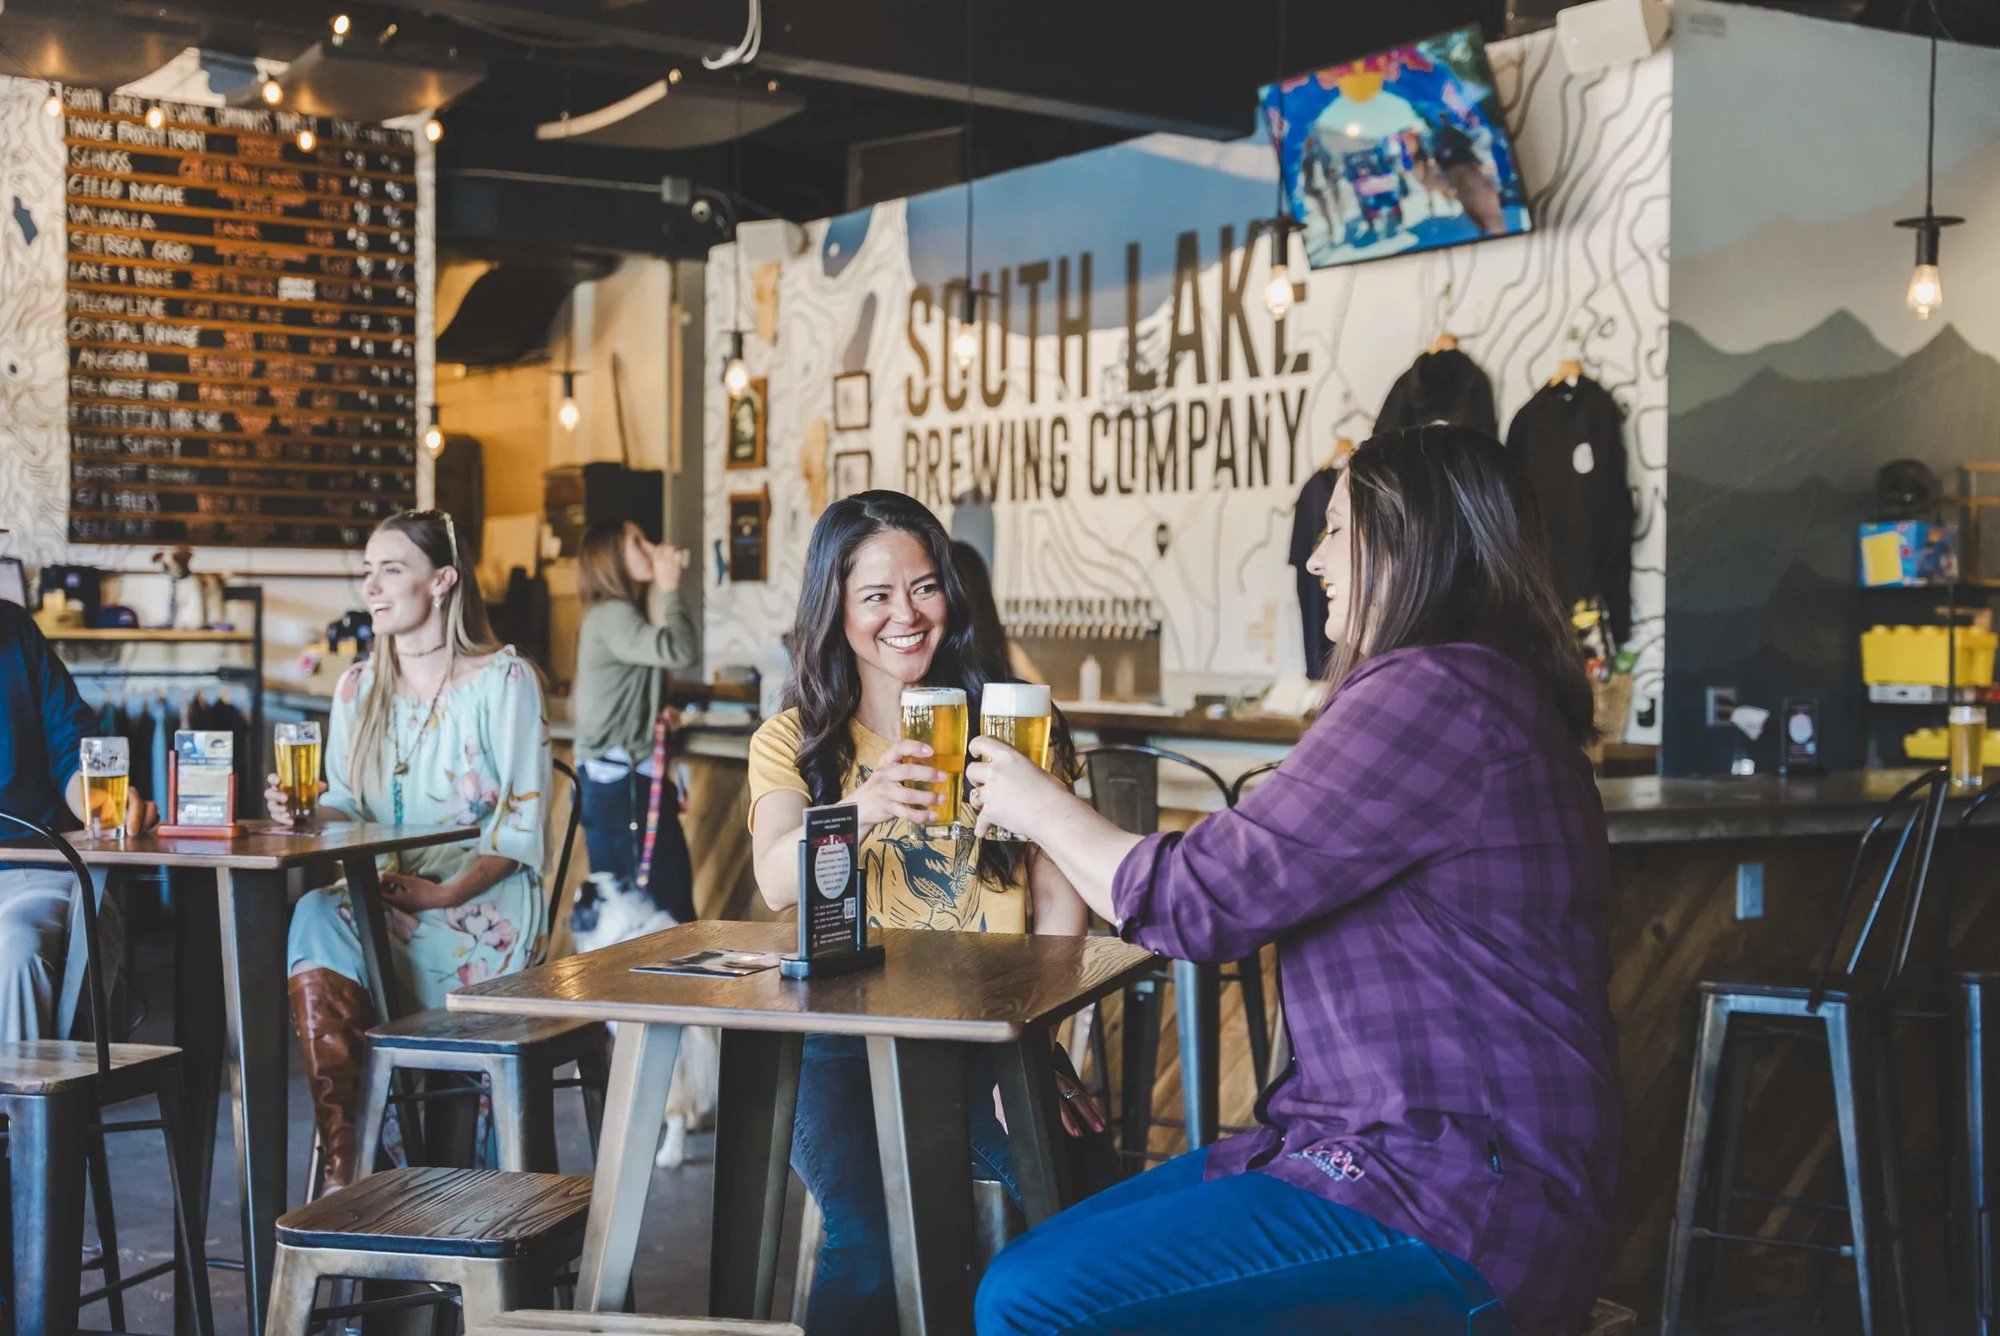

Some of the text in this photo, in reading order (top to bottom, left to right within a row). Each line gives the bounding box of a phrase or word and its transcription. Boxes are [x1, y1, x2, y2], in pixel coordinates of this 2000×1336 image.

[907, 251, 1093, 417] SOUTH
[904, 388, 1309, 505] BREWING COMPANY
